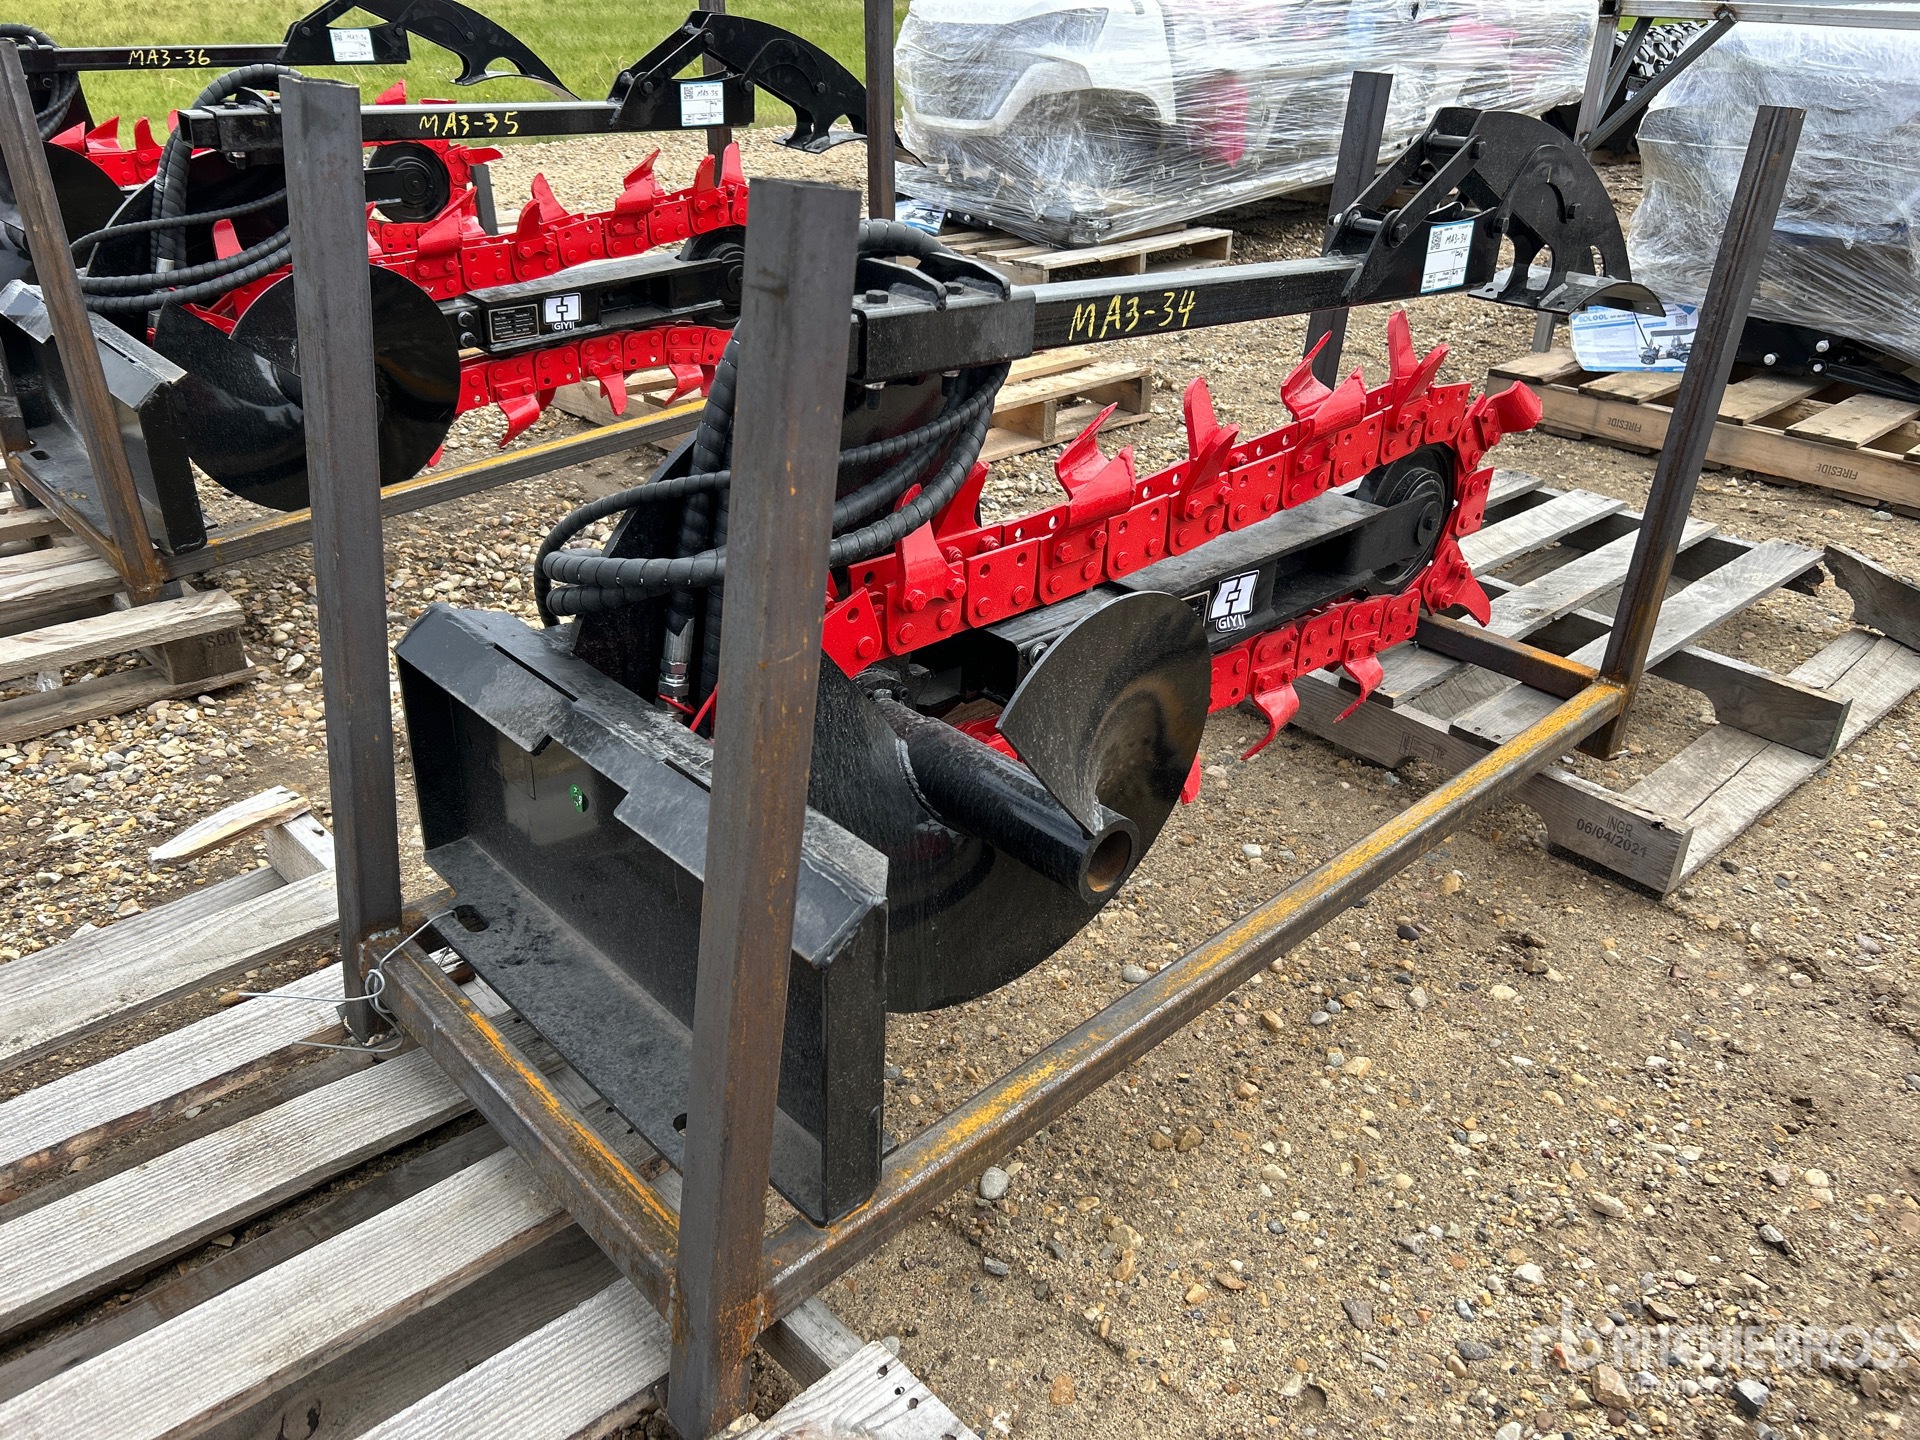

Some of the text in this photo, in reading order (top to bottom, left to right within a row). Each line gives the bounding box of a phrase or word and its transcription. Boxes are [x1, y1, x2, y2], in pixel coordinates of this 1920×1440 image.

[128, 49, 211, 67] MA3-36
[419, 111, 519, 137] MA3-35
[1068, 289, 1197, 341] MA3-34
[553, 321, 573, 331] GIYI
[1815, 462, 1859, 480] FIRESIDE
[1218, 613, 1243, 630] GIYI
[1605, 815, 1634, 838] INGR
[1576, 818, 1648, 858] 06/04/2021
